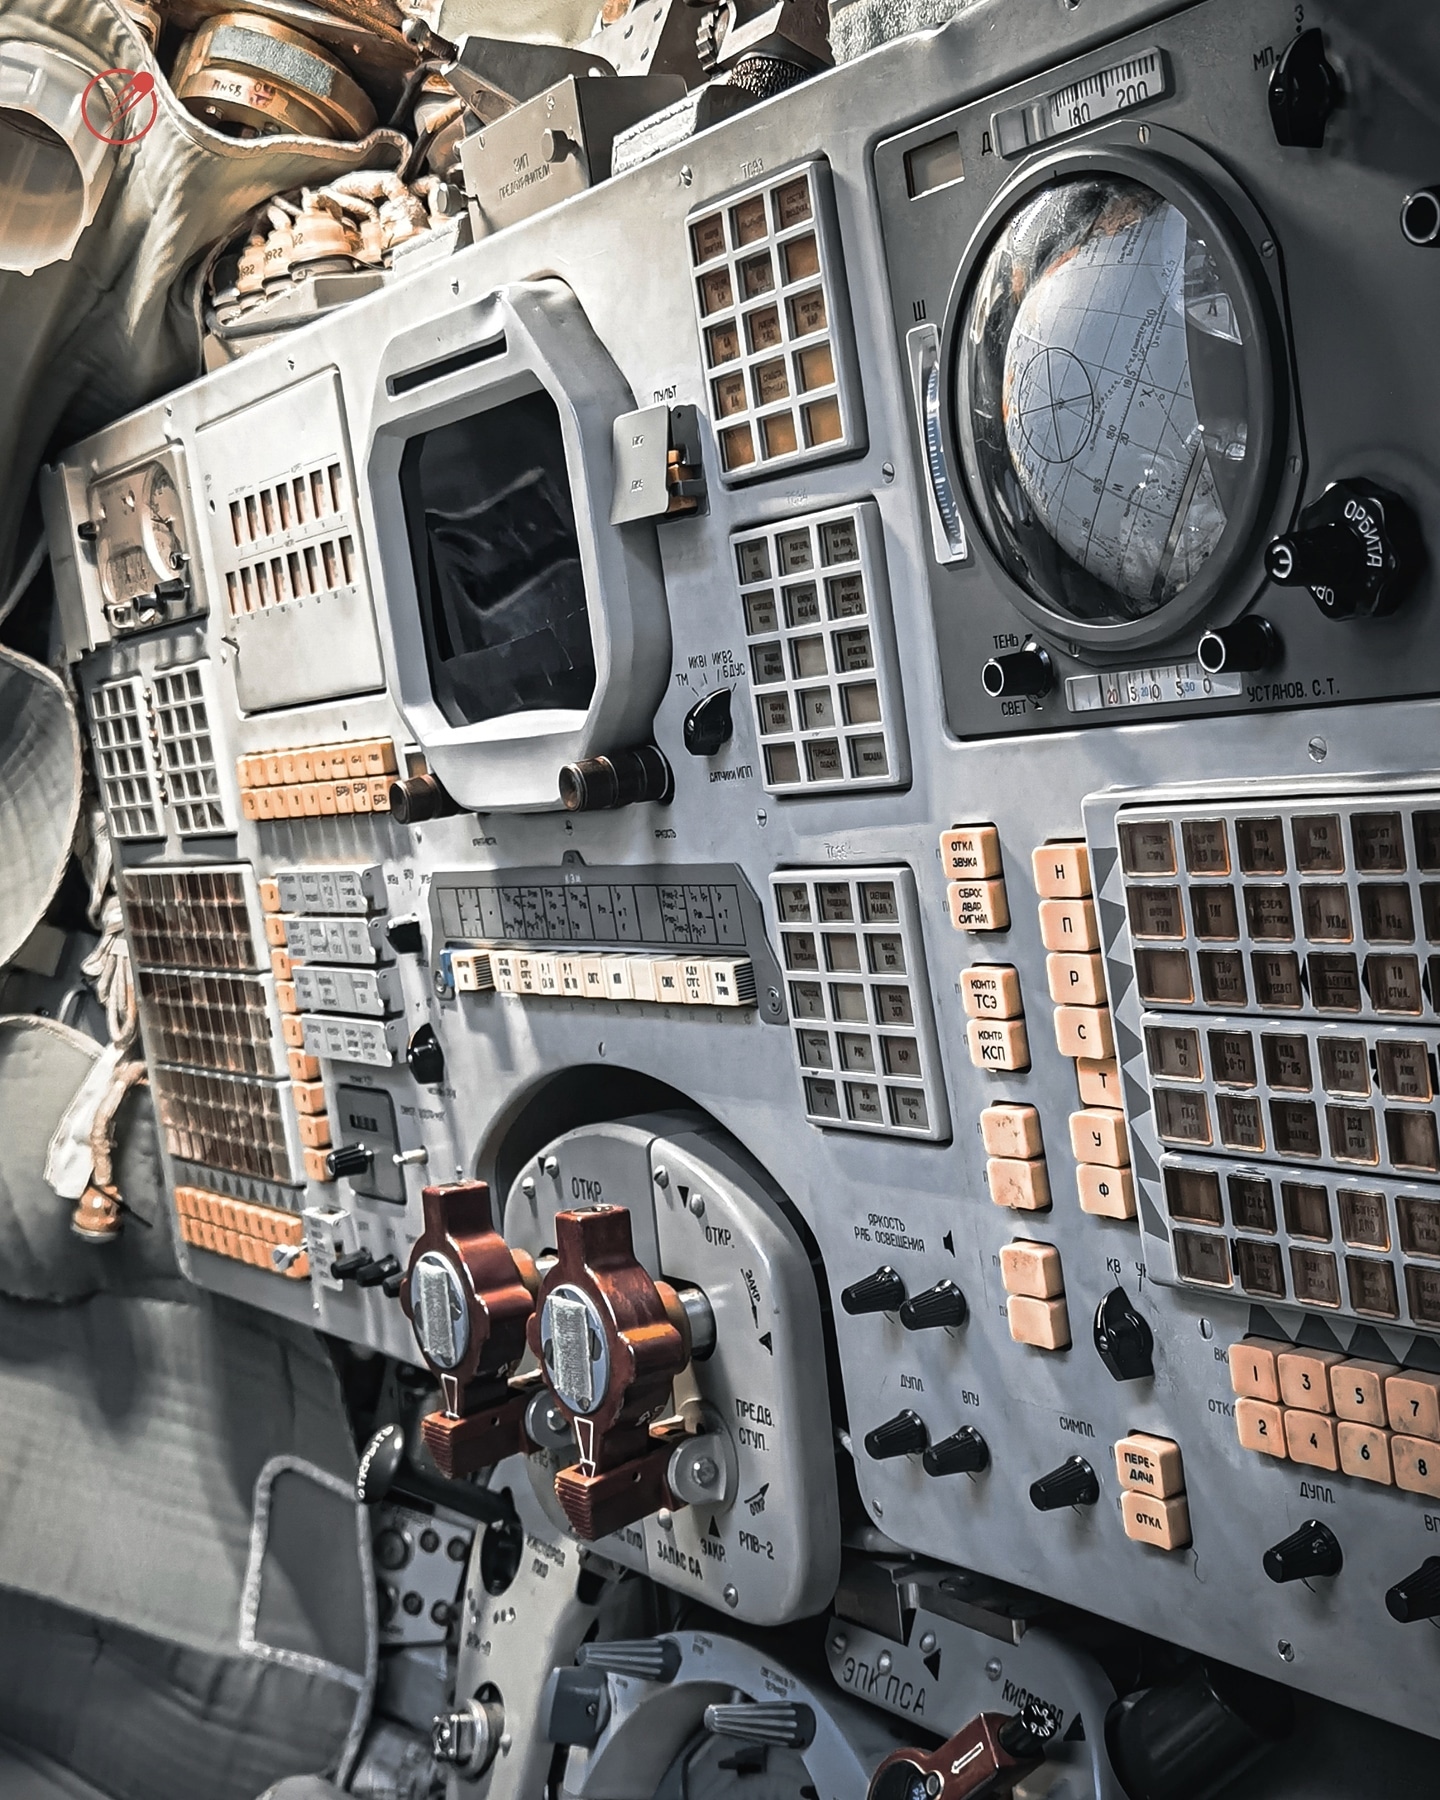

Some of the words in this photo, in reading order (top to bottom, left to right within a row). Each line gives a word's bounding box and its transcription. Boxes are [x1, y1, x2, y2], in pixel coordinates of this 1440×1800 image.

[1116, 81, 1148, 108] 200
[1069, 103, 1090, 126] 180
[1344, 500, 1383, 567] ОРБИТА
[993, 634, 1019, 649] ТЕНЬ
[722, 663, 745, 678] БДУС
[675, 673, 689, 686] ТМ
[1107, 689, 1119, 704] 20
[1247, 683, 1308, 702] УСТАНОВ.
[1001, 700, 1026, 716] СВЕТ
[951, 841, 974, 851] ОТКЛ
[952, 857, 977, 868] ЗВУКА
[1055, 864, 1065, 879] Н
[958, 888, 982, 898] СБРОС
[958, 914, 988, 924] СИГНАЛ
[1062, 917, 1073, 933] П
[1069, 970, 1079, 986] Р
[974, 994, 997, 1009] ТСЭ
[1078, 1025, 1087, 1039] С
[981, 1045, 1006, 1061] КСП
[1099, 1073, 1107, 1088] Т
[1092, 1131, 1101, 1147] У
[1099, 1183, 1109, 1197] Ф
[868, 1213, 905, 1232] ЯРКОСТЬ
[854, 1226, 873, 1242] РАБ.
[875, 1231, 925, 1252] ОСВЕЩЕНИЯ
[1107, 1257, 1121, 1273] КВ
[1214, 1347, 1229, 1365] ВК
[962, 1390, 979, 1406] ВПУ
[1302, 1373, 1311, 1390] 3
[1355, 1387, 1364, 1404] 5
[1410, 1400, 1420, 1417] 7
[735, 1398, 775, 1428] ПРЕДВ.
[739, 1427, 769, 1451] СТУП.
[1258, 1419, 1267, 1435] 2
[1309, 1433, 1318, 1449] 4
[1361, 1444, 1370, 1460] 6
[1418, 1459, 1427, 1476] 8
[357, 1425, 394, 1499] ОТКРЫТЬ
[1124, 1452, 1155, 1468] ПЕРЕ-
[1129, 1468, 1154, 1485] ДАЧА
[1136, 1512, 1162, 1530] ОТКЛ
[739, 1530, 774, 1560] РПВ-2
[657, 1540, 687, 1571] ЗАПАС
[688, 1556, 703, 1580] СА
[885, 1676, 926, 1716] ПСА
